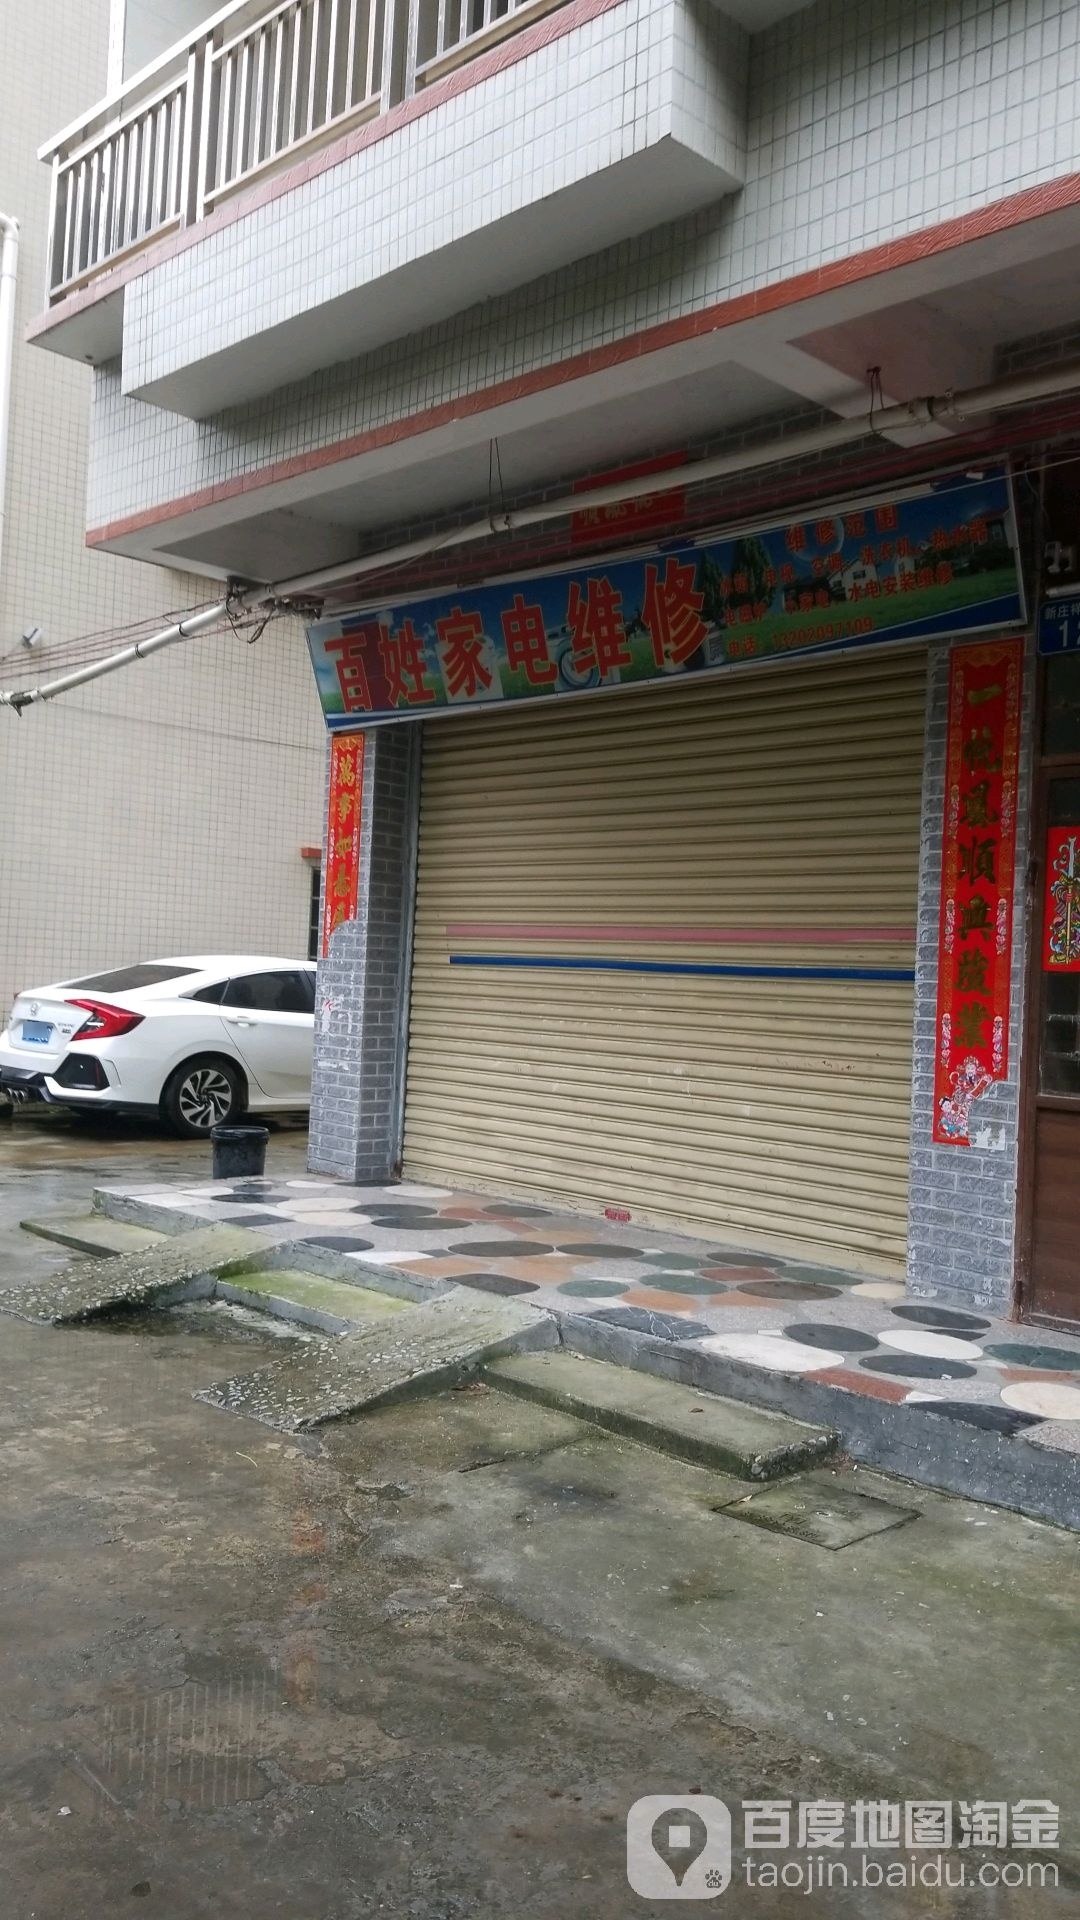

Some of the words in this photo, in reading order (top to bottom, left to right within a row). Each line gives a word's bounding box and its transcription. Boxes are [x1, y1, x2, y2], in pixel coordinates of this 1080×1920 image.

[786, 504, 897, 553] 维修范围
[847, 561, 953, 602] 水电安装维修
[325, 558, 709, 713] 百姓家电维修
[728, 635, 755, 657] 电话
[1059, 619, 1080, 648] 1
